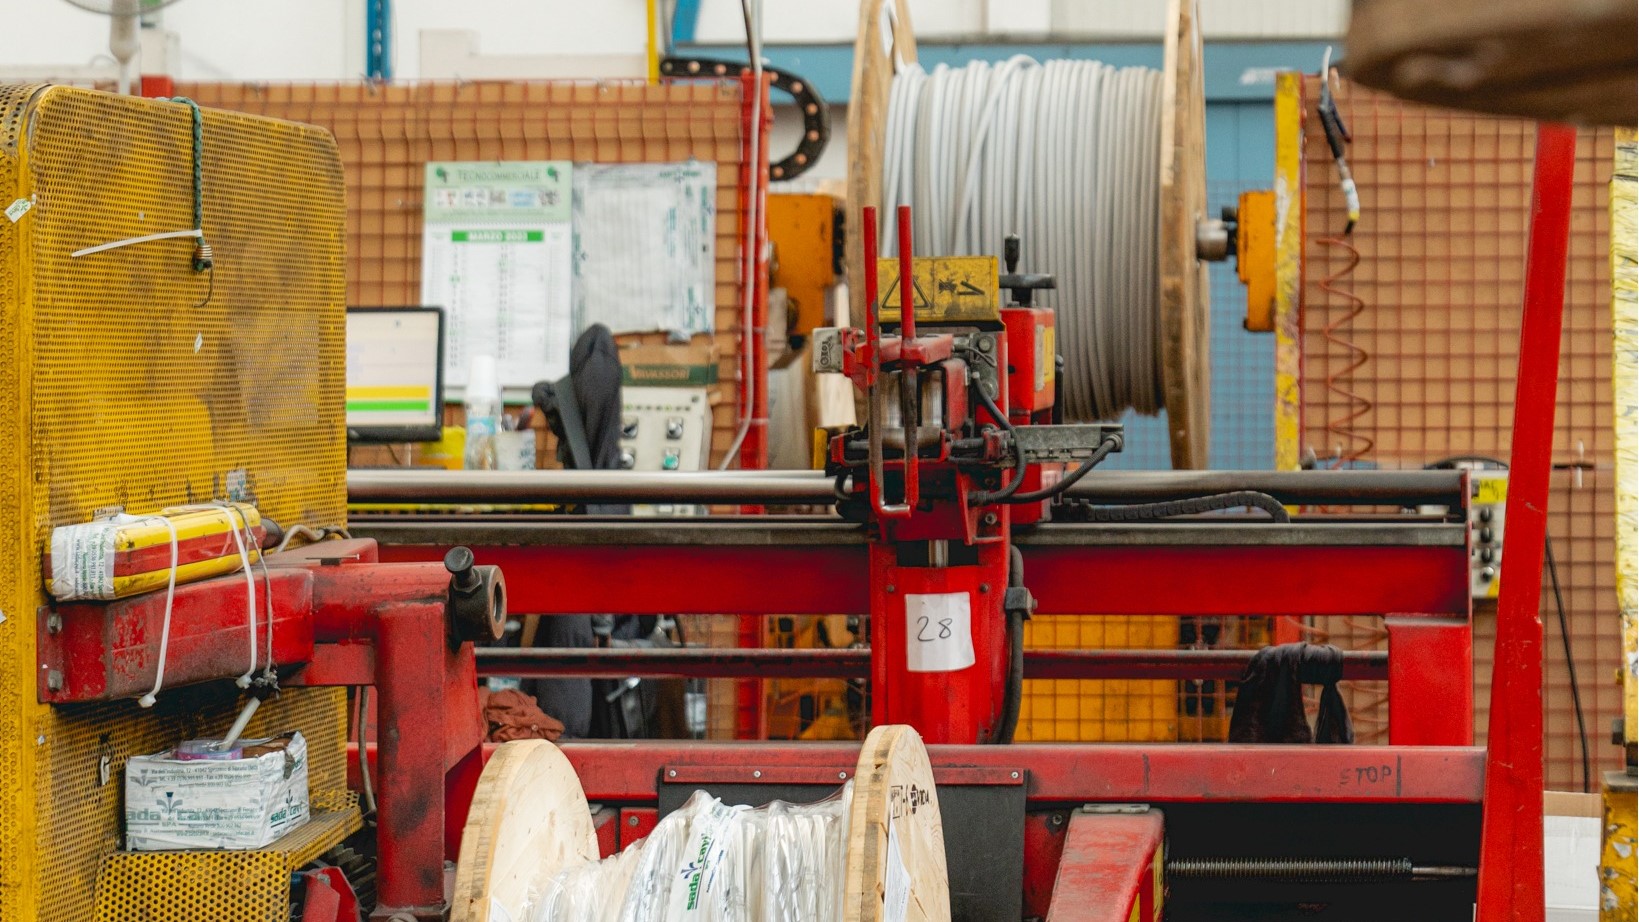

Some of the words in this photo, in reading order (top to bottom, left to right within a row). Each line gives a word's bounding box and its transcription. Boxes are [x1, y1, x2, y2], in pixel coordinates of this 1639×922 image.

[468, 231, 503, 241] MARZO
[917, 615, 953, 642] 28
[1339, 764, 1392, 785] STOP
[126, 808, 161, 820] ada
[270, 808, 287, 823] sada
[687, 872, 701, 910] sada
[697, 833, 711, 864] cavi
